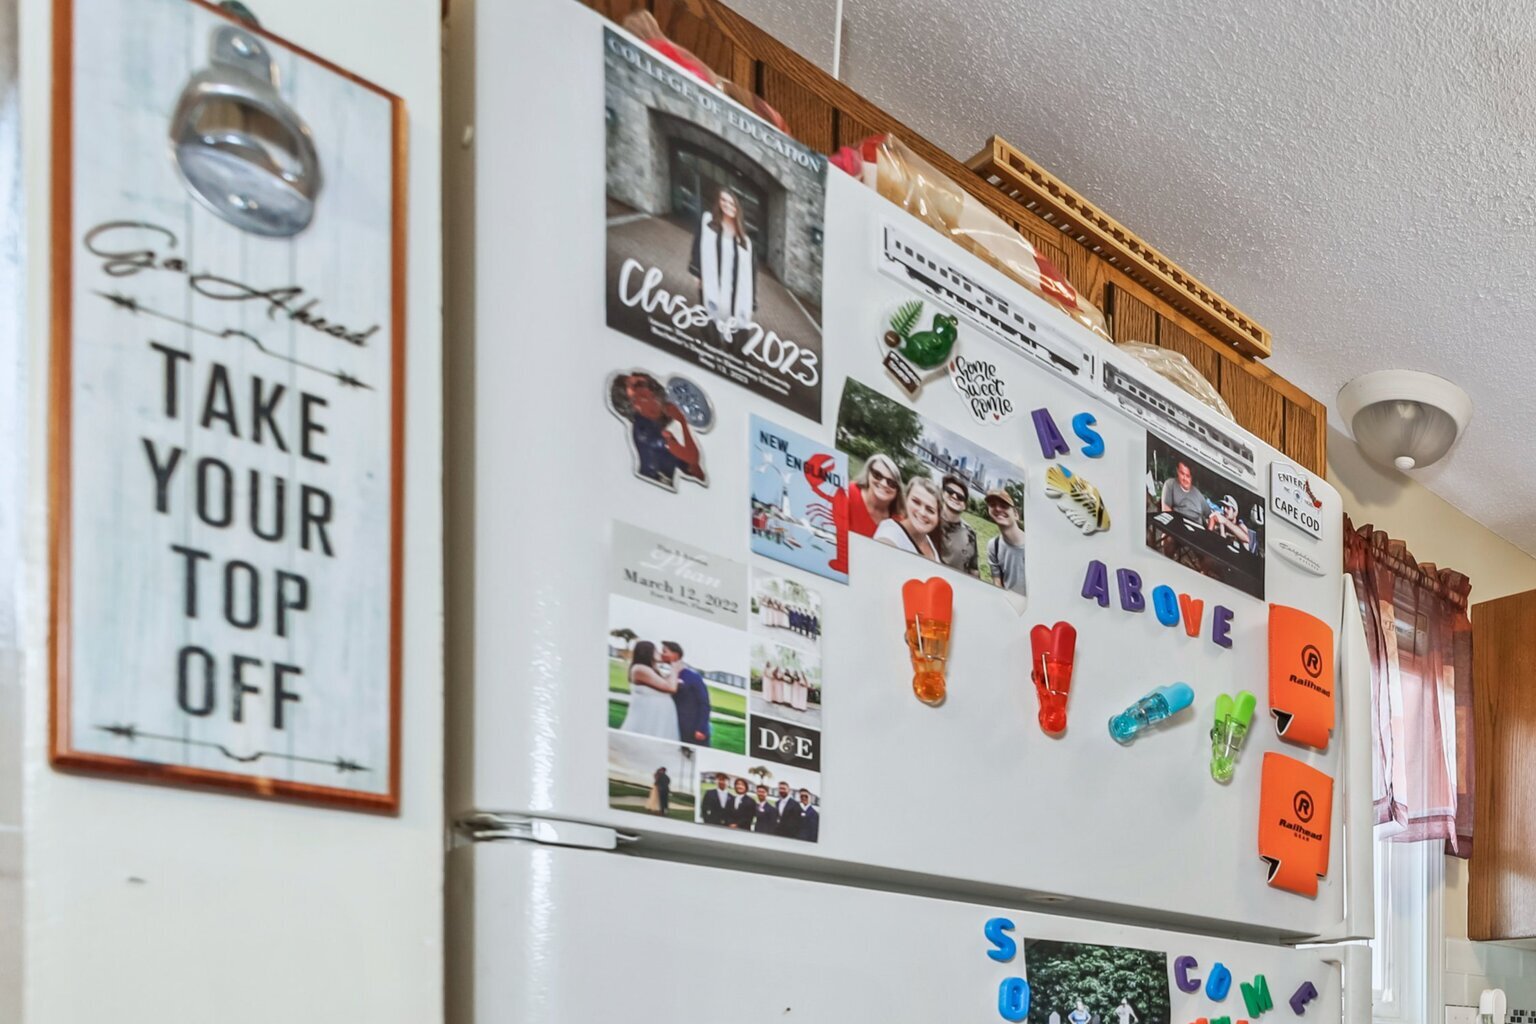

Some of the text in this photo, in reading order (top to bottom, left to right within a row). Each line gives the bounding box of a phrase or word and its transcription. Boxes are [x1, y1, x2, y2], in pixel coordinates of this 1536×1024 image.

[609, 38, 821, 173] COLLEGE OF EDUCATION
[84, 220, 379, 347] Go Ahead
[618, 257, 713, 330] Class
[741, 322, 819, 388] 2023
[956, 355, 996, 381] home
[150, 341, 330, 465] TAKE
[971, 396, 1013, 420] home
[760, 430, 789, 453] NEW
[1030, 407, 1106, 460] AS
[786, 452, 841, 487] ENGLAND
[142, 437, 337, 558] YOUR
[1274, 497, 1299, 520] CAPE
[1300, 512, 1320, 532] COD
[170, 543, 312, 639] TOP
[623, 568, 674, 594] March
[680, 585, 701, 602] 12,
[705, 594, 739, 614] 2022
[1081, 560, 1235, 649] ABOVE
[176, 646, 304, 732] OFF
[1289, 674, 1330, 698] Railhead
[758, 727, 813, 760] D&E
[1279, 818, 1322, 841] Railhead
